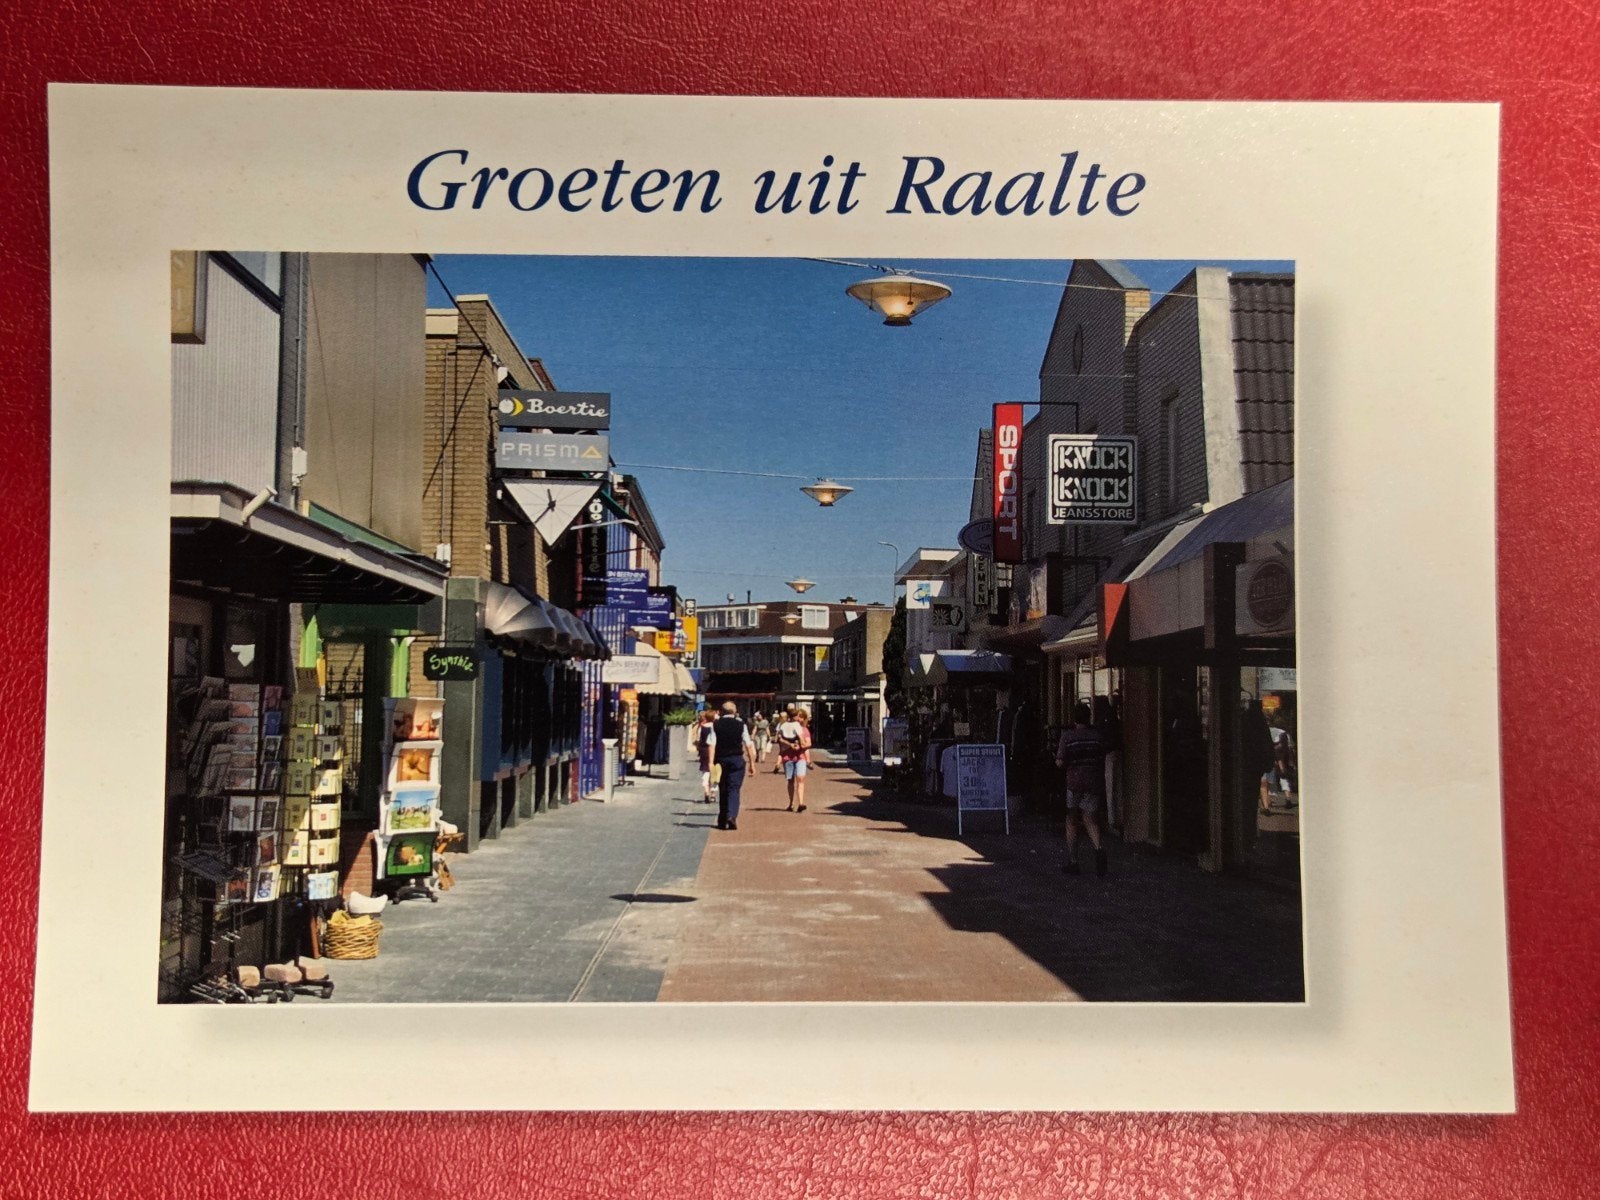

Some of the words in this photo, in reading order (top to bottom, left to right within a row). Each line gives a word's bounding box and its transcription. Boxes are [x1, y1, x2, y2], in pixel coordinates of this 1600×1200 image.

[407, 150, 722, 213] Groeten
[755, 155, 867, 215] uit
[886, 152, 1147, 217] Raalte
[527, 398, 608, 418] Boertie
[1059, 446, 1128, 470] KNOCK
[998, 424, 1018, 541] SPORT
[1059, 476, 1128, 501] KNOCK
[1054, 508, 1133, 519] JEANSSTORE
